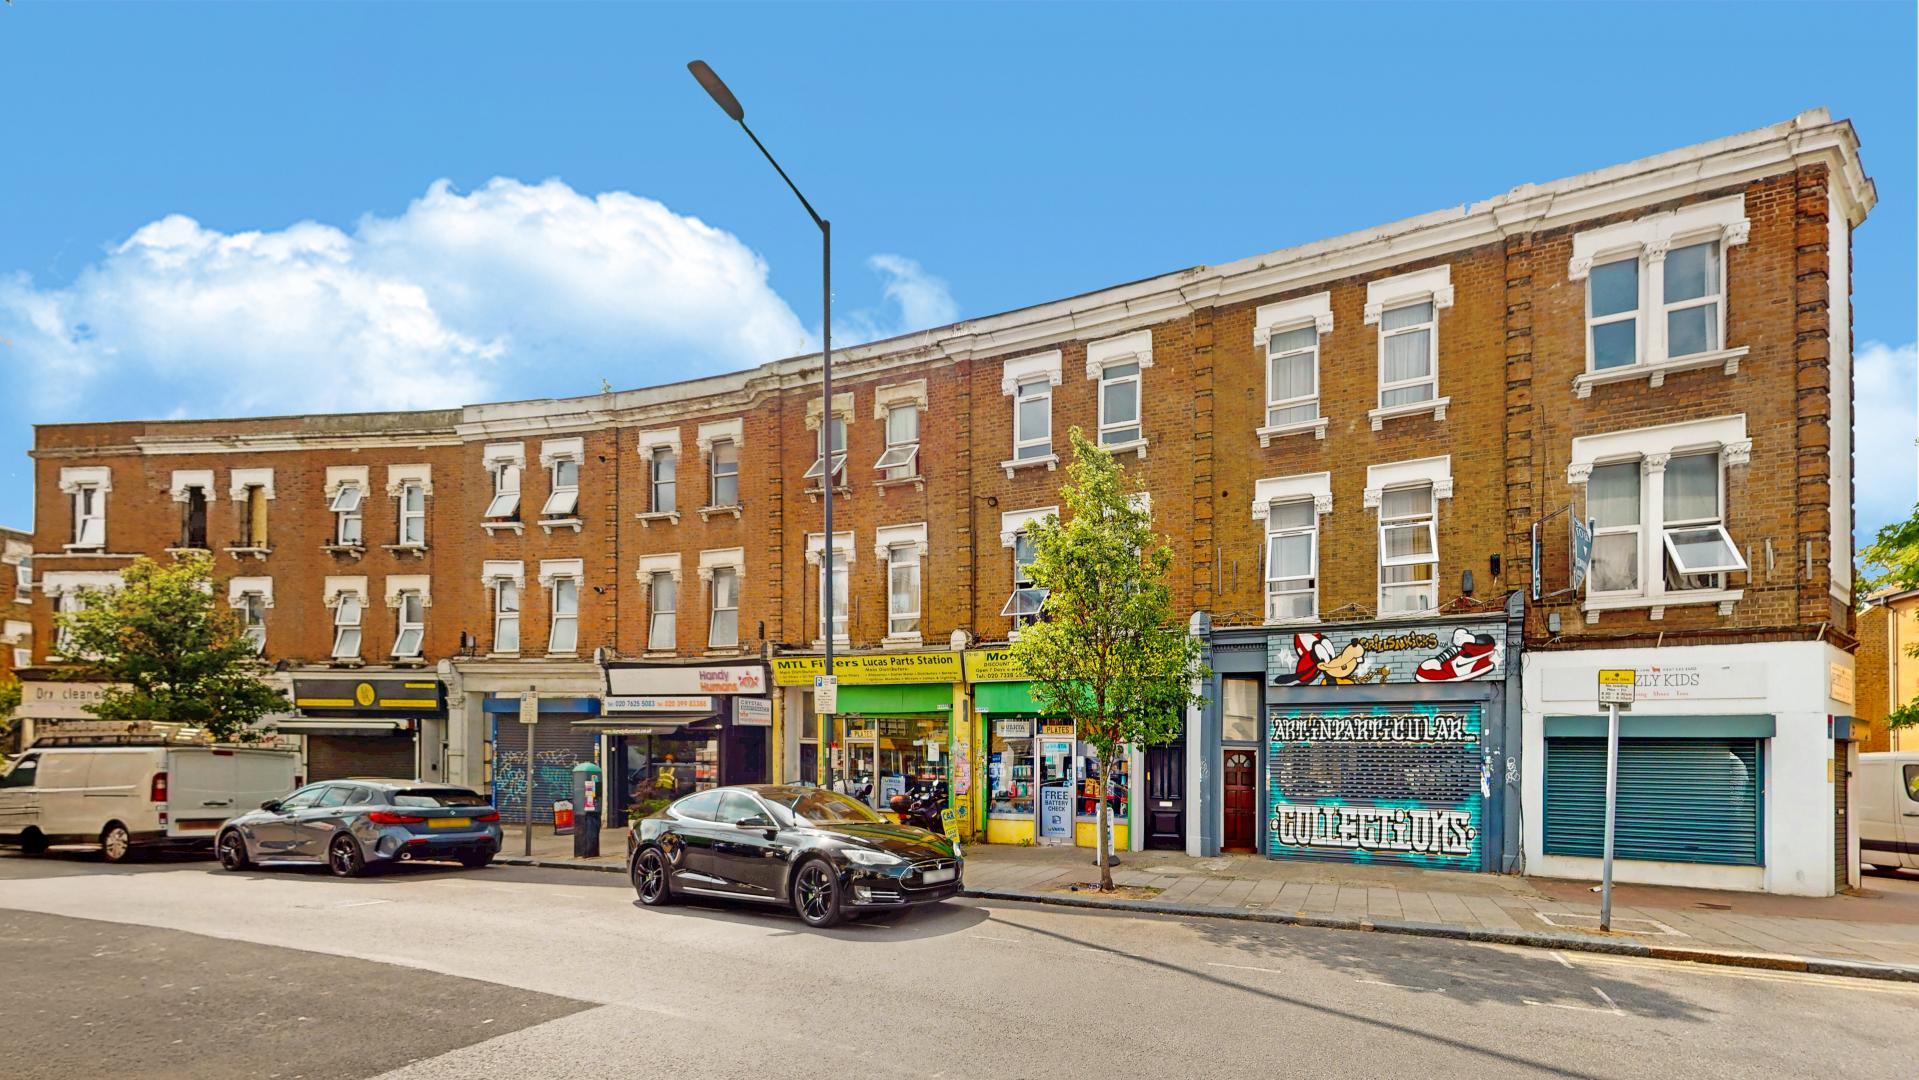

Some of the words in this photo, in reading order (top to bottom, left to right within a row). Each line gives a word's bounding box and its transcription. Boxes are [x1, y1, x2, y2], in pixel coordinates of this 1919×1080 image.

[777, 660, 807, 669] MTL
[811, 658, 859, 668] Fiers
[862, 658, 888, 667] Lucas
[890, 657, 915, 666] Parts
[917, 655, 953, 665] Station
[699, 670, 730, 682] Handy
[1635, 674, 1661, 687] ZLY
[1663, 673, 1700, 687] KIDS
[700, 682, 738, 692] Humans
[36, 687, 54, 700] Dry
[854, 730, 873, 738] PLATES
[1045, 790, 1069, 800] FREE
